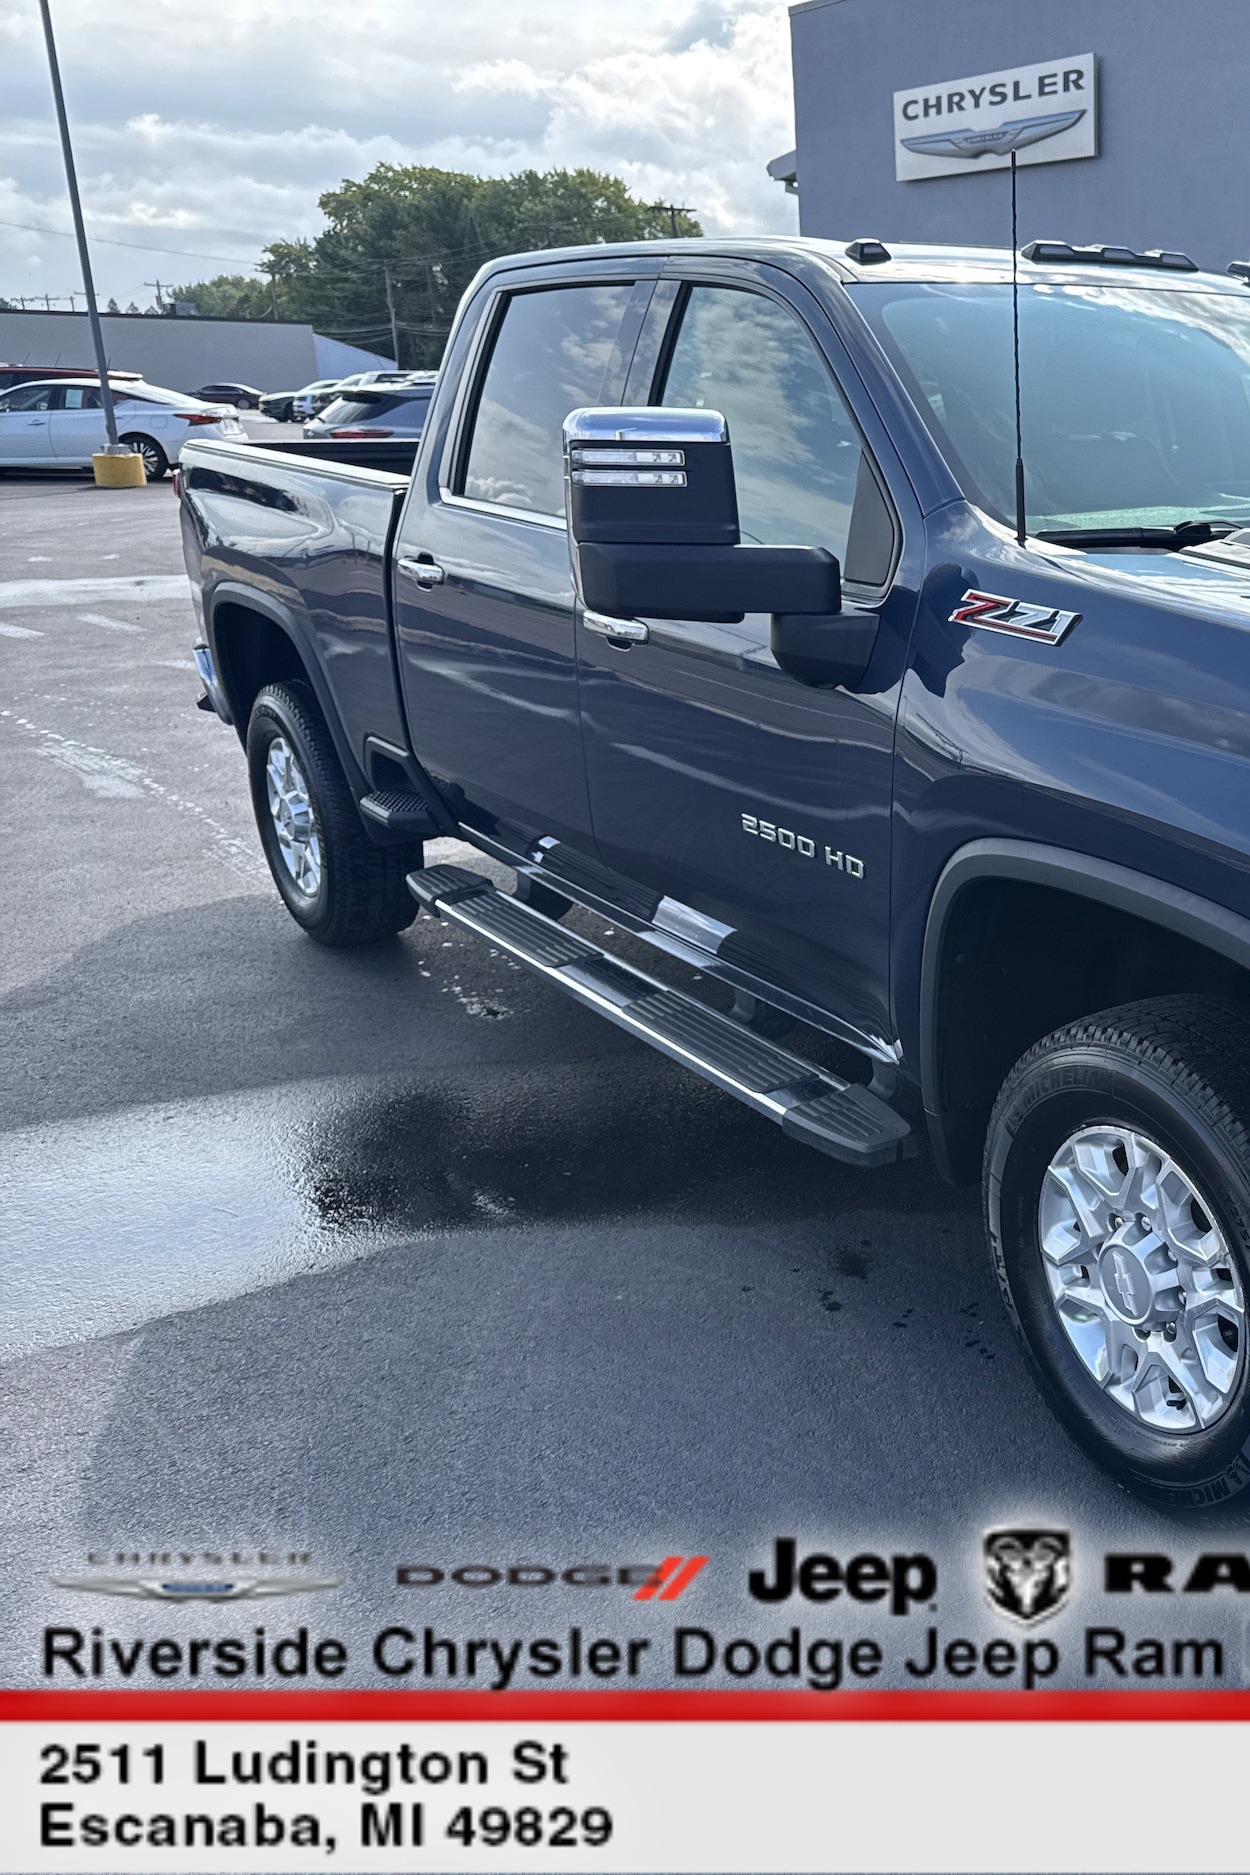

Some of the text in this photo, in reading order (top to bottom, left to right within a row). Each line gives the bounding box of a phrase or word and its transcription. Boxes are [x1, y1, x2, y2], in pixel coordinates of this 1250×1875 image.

[902, 69, 1085, 121] CHRYSLER
[948, 588, 1083, 646] Z71
[741, 813, 865, 879] 2500 HD
